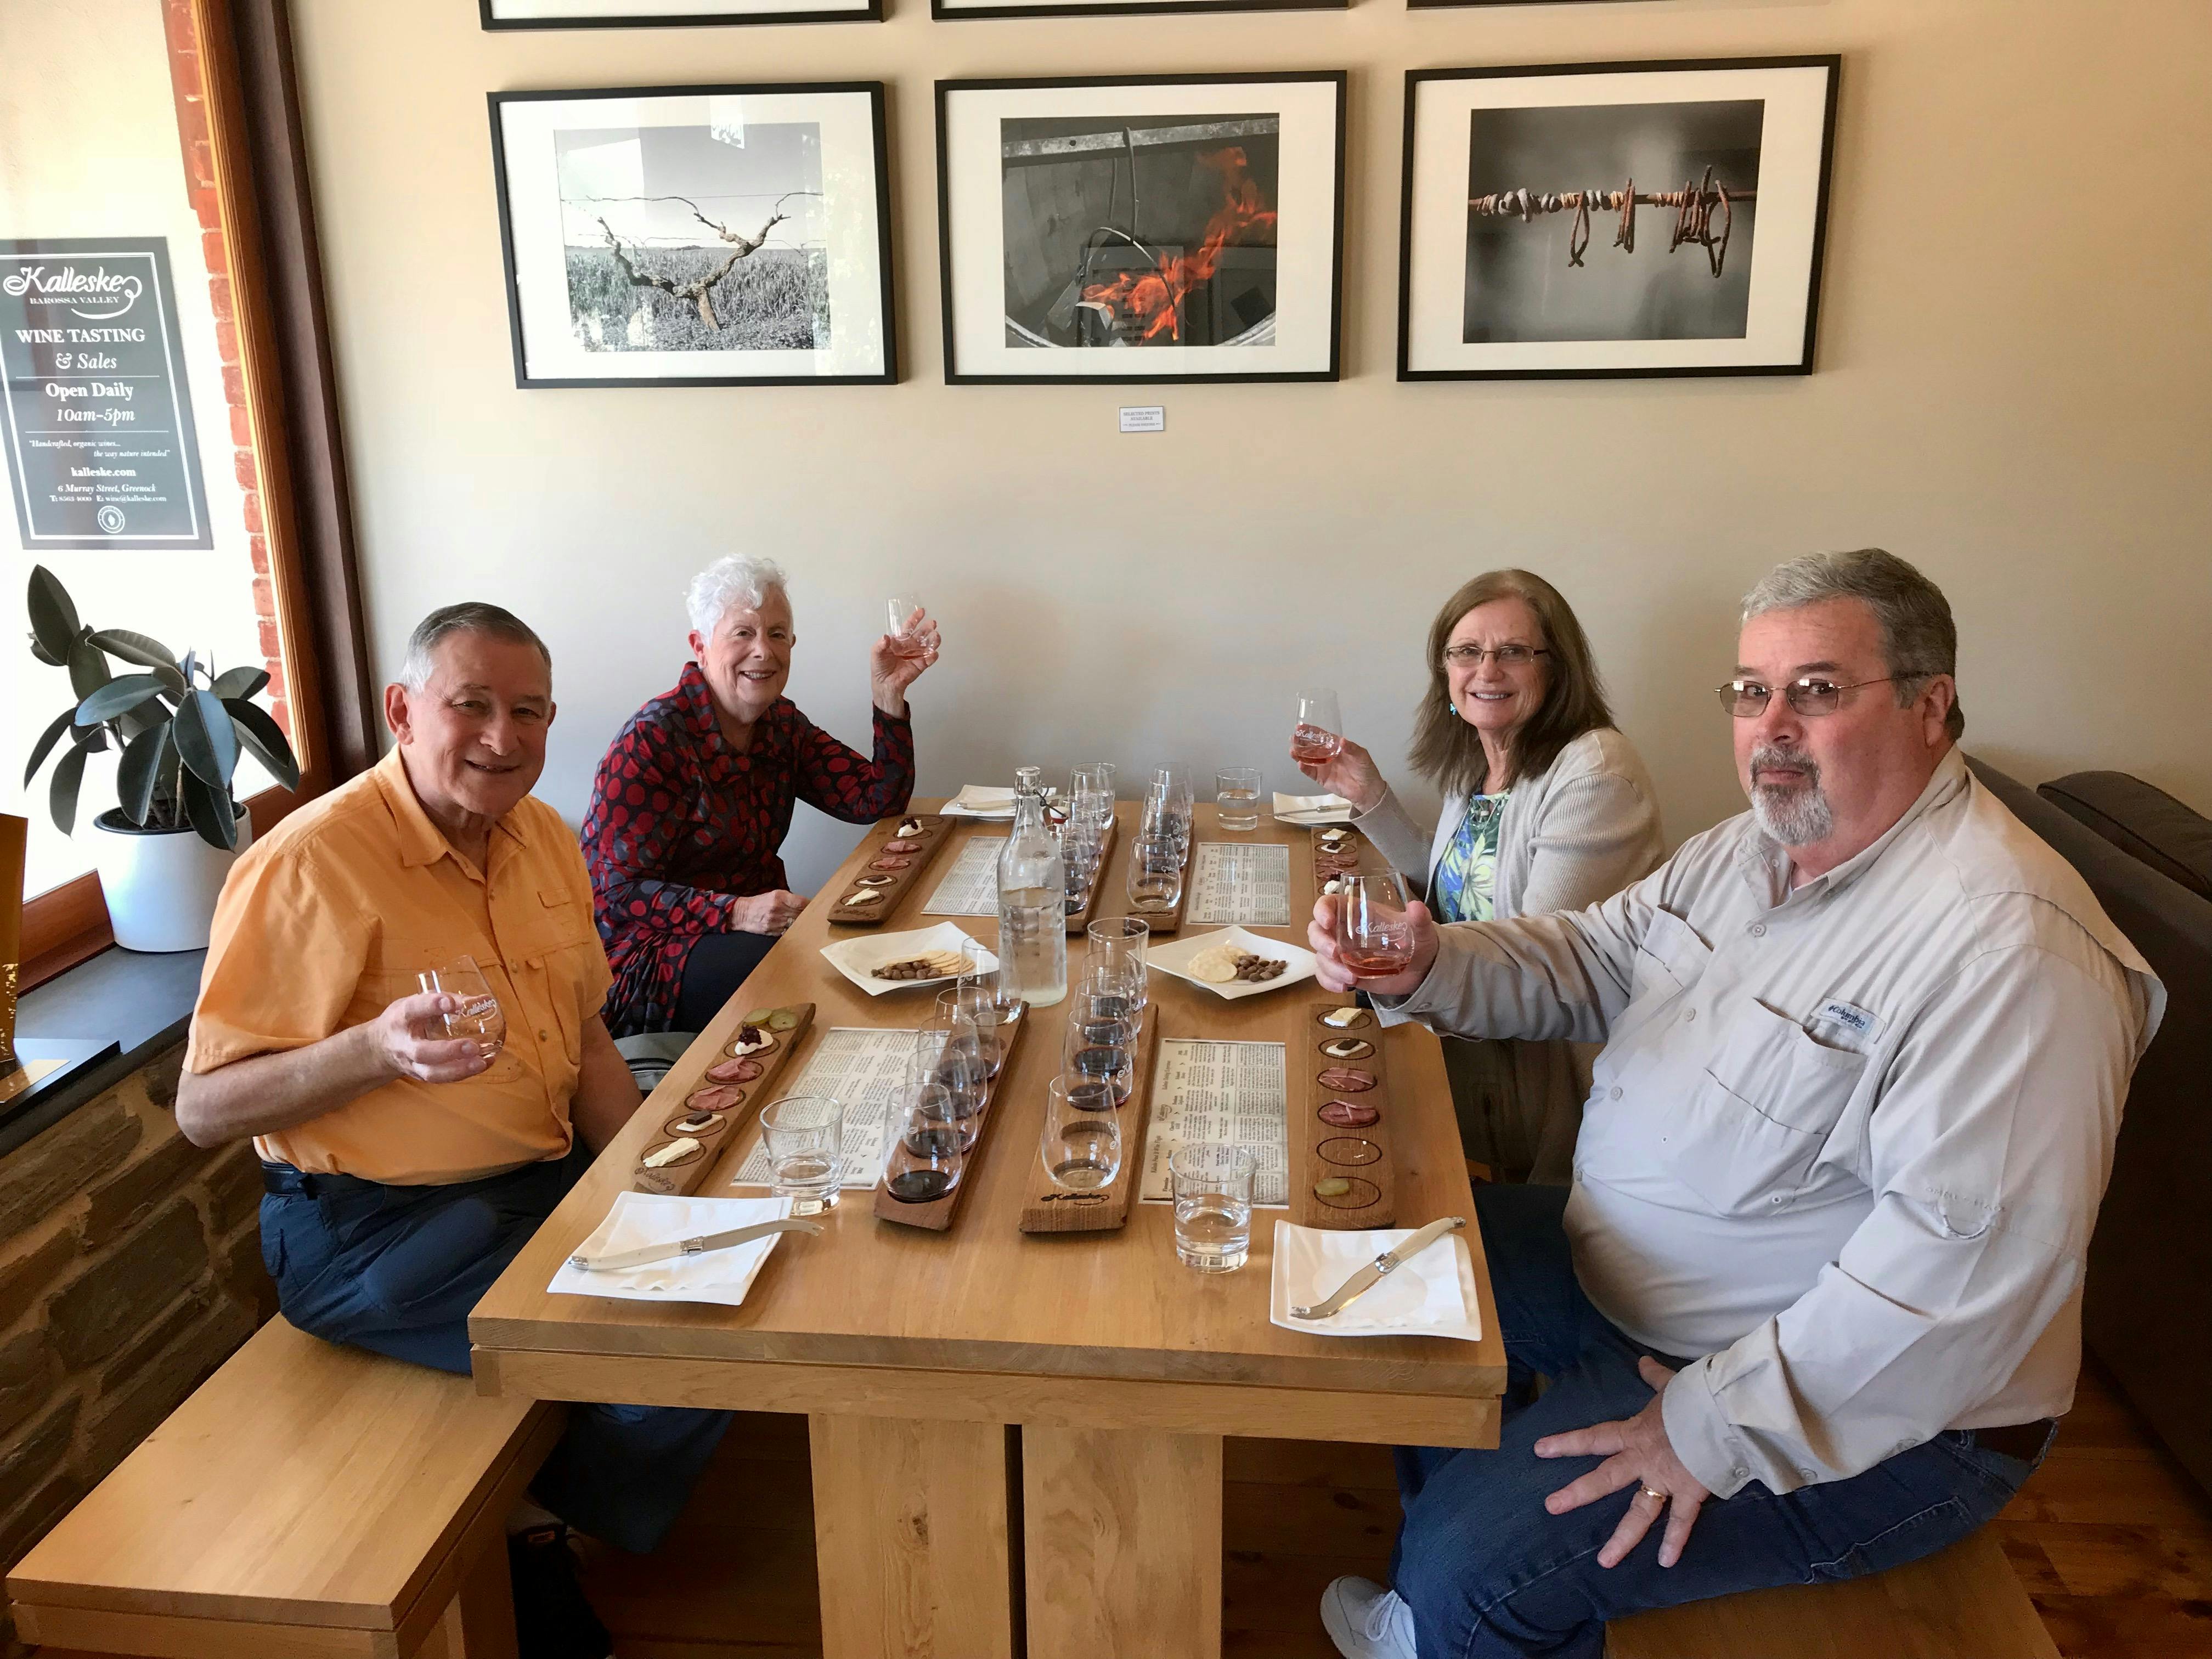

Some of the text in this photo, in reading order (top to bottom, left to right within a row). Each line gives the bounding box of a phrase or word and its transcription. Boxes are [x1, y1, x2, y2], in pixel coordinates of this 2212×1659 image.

[3, 266, 143, 299] Kalleske
[30, 296, 78, 305] BAROSSA
[15, 328, 145, 343] WINE TASTING
[56, 352, 117, 370] & Sales
[46, 382, 134, 402] Open Daily
[73, 439, 96, 449] organic
[104, 451, 118, 459] way
[71, 467, 136, 477] kalleske.com
[65, 484, 94, 494] Murray
[96, 484, 120, 493] Street,
[121, 484, 156, 493] Greenock
[105, 495, 167, 503] wine@kalleske.com
[1832, 1005, 1865, 1026] Columbia
